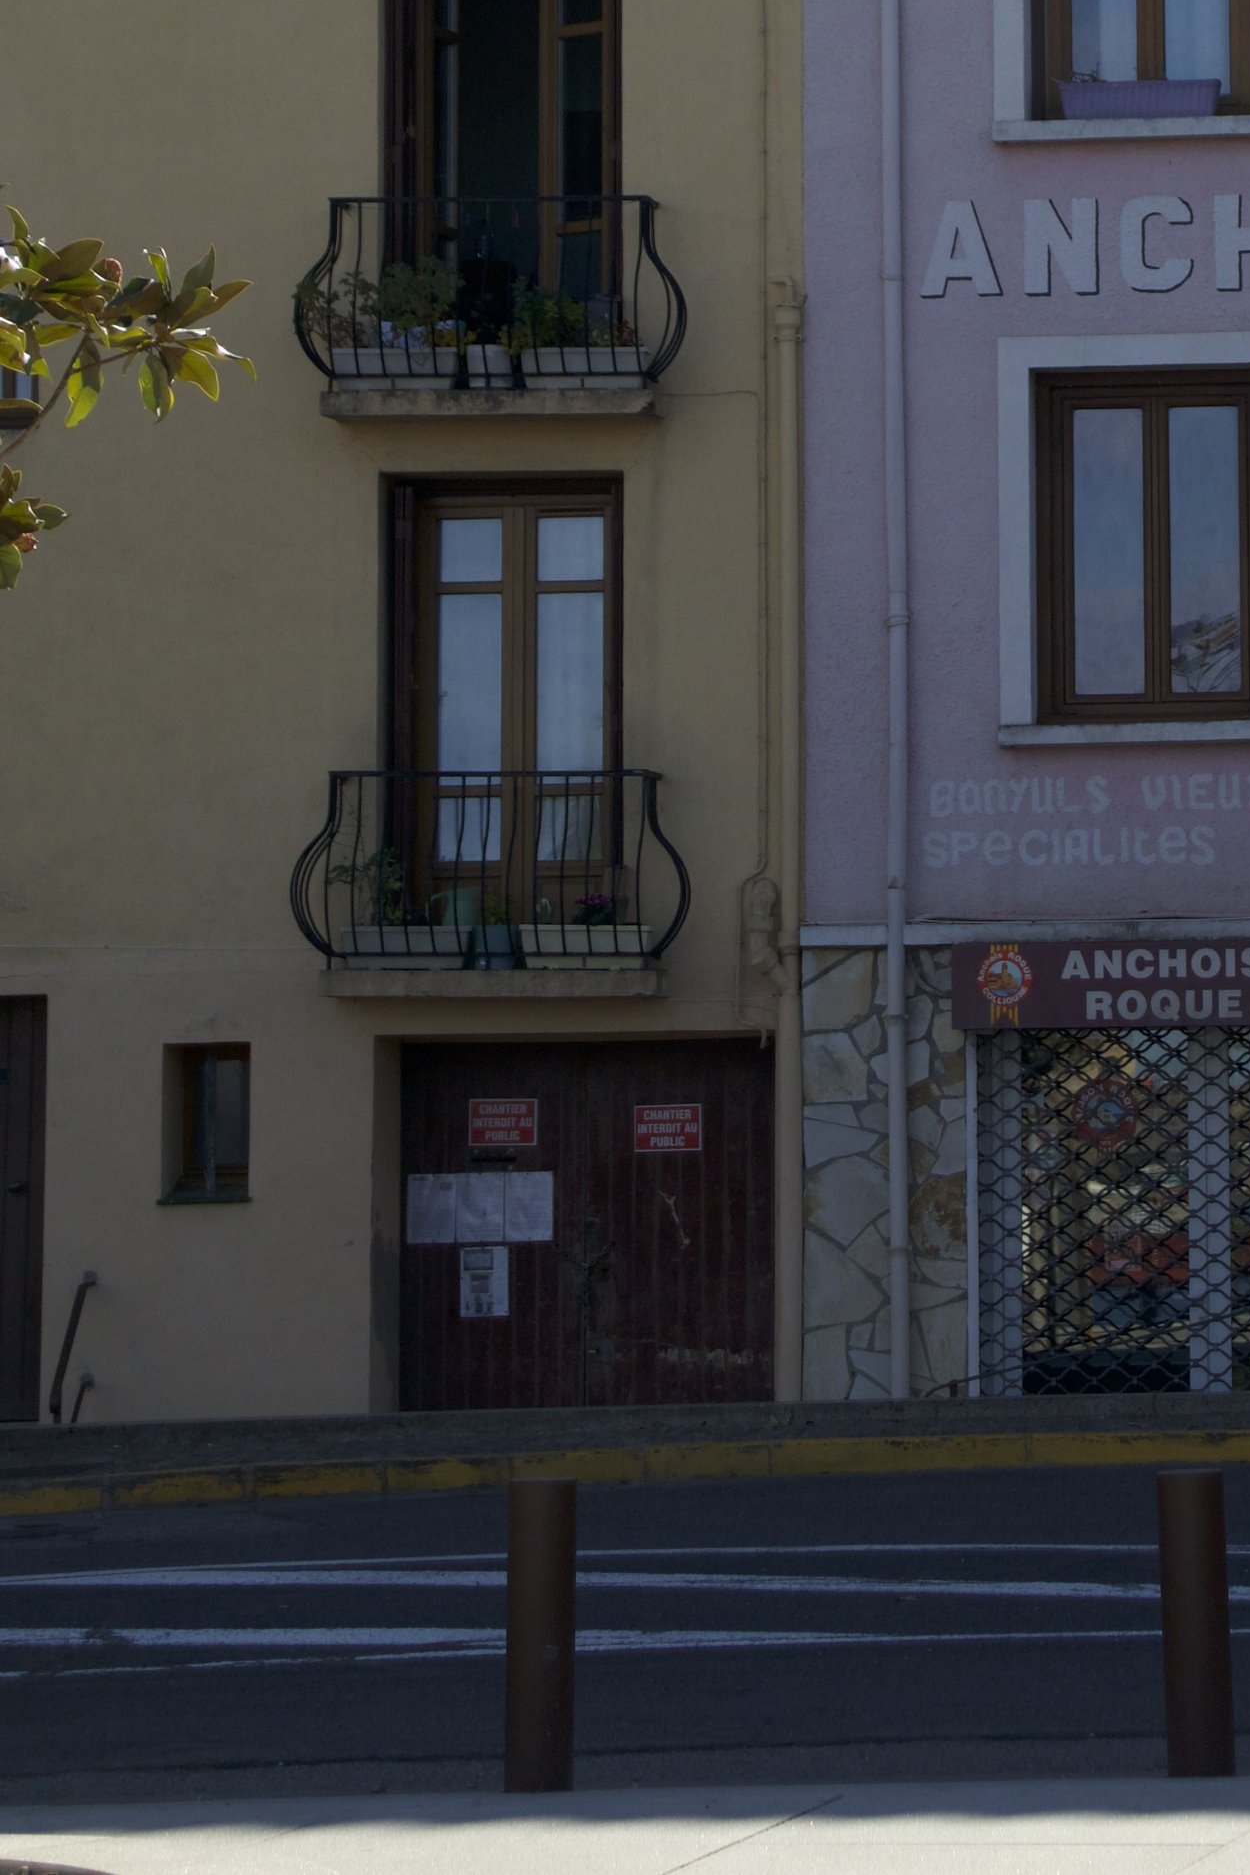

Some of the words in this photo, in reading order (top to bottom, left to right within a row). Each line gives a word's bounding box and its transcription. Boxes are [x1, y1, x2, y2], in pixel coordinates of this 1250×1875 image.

[1007, 951, 1032, 980] ROQUE
[1085, 988, 1243, 1022] ROQUE
[478, 1103, 527, 1115] CHANTIER
[643, 1108, 692, 1121] CHANTIER
[472, 1117, 516, 1128] INTERDIT
[519, 1116, 534, 1128] AU
[637, 1122, 681, 1135] INTERDIT
[684, 1121, 698, 1134] AU
[485, 1130, 520, 1142] PUBLIC
[650, 1135, 685, 1148] PUBLIC
